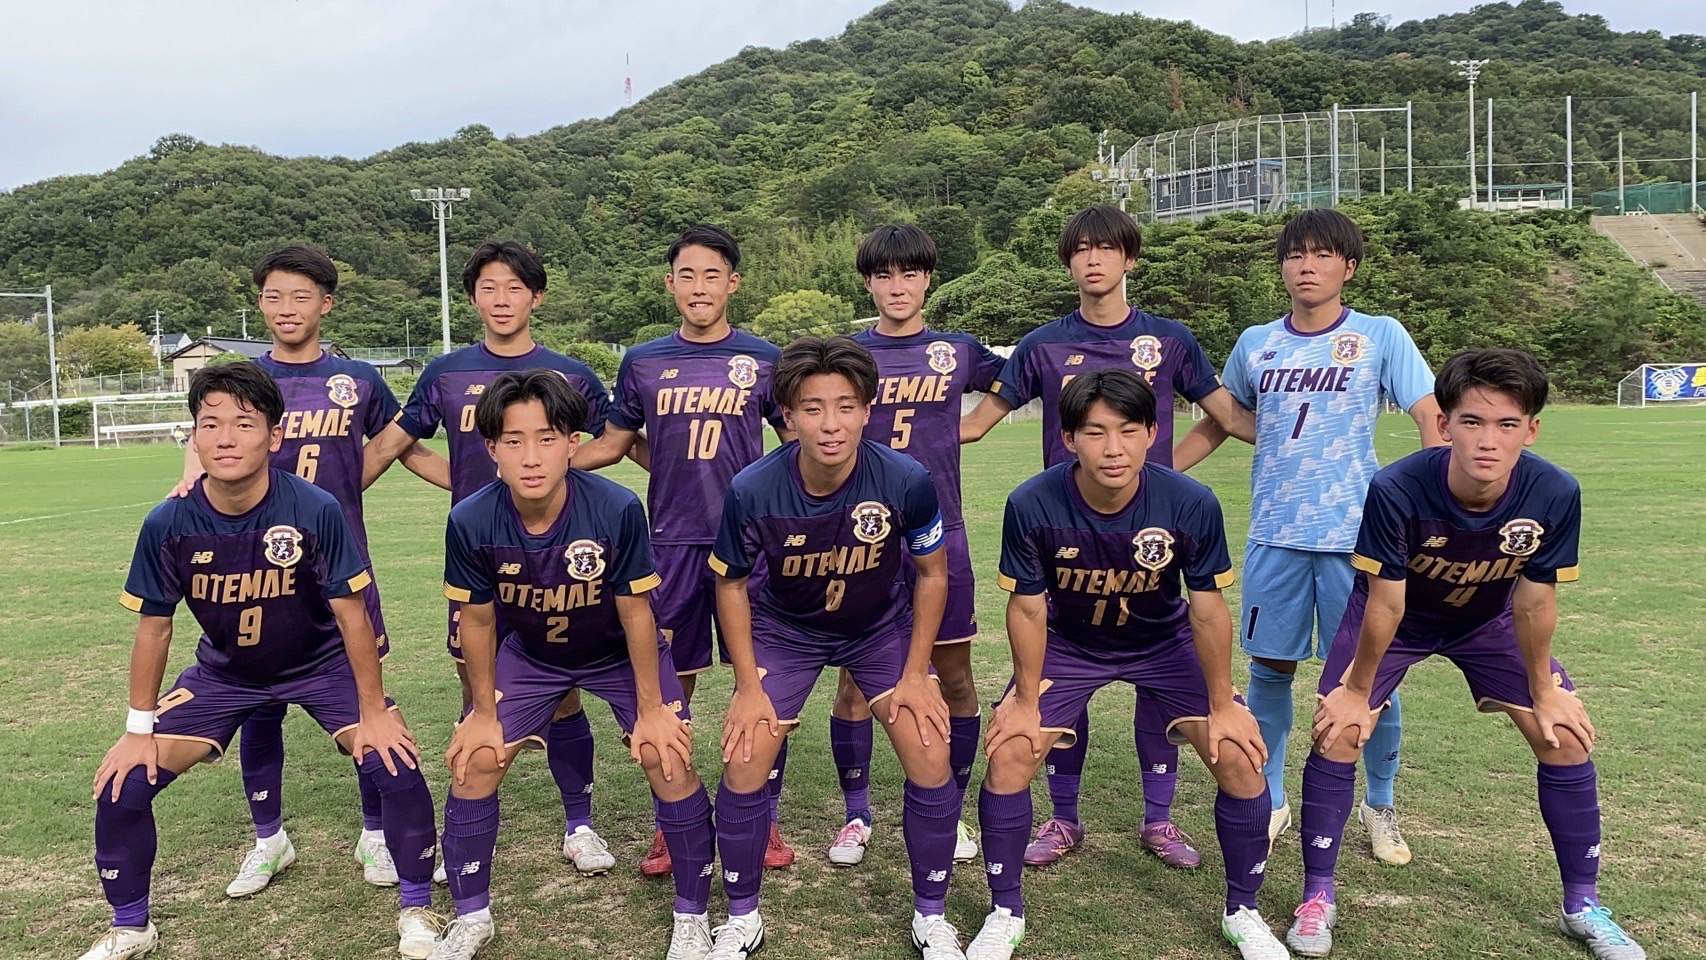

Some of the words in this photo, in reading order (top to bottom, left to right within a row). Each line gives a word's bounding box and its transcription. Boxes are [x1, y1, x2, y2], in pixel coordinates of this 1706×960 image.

[1259, 367, 1355, 393] OTEMAE
[656, 386, 751, 416] OTEMAE
[890, 409, 915, 450] 5
[1291, 402, 1310, 440] 1
[687, 419, 723, 460] 10
[296, 444, 320, 484] 6
[782, 542, 886, 578] OTEMAE
[1407, 553, 1530, 585] OTEMAE
[192, 568, 296, 604] OTEMAE
[498, 580, 603, 613] OTEMAE
[825, 579, 846, 612] 8
[1056, 567, 1166, 596] OTEMAE
[237, 606, 263, 647] 9
[1091, 597, 1130, 626] 11
[1246, 605, 1261, 641] 1
[546, 616, 569, 643] 2
